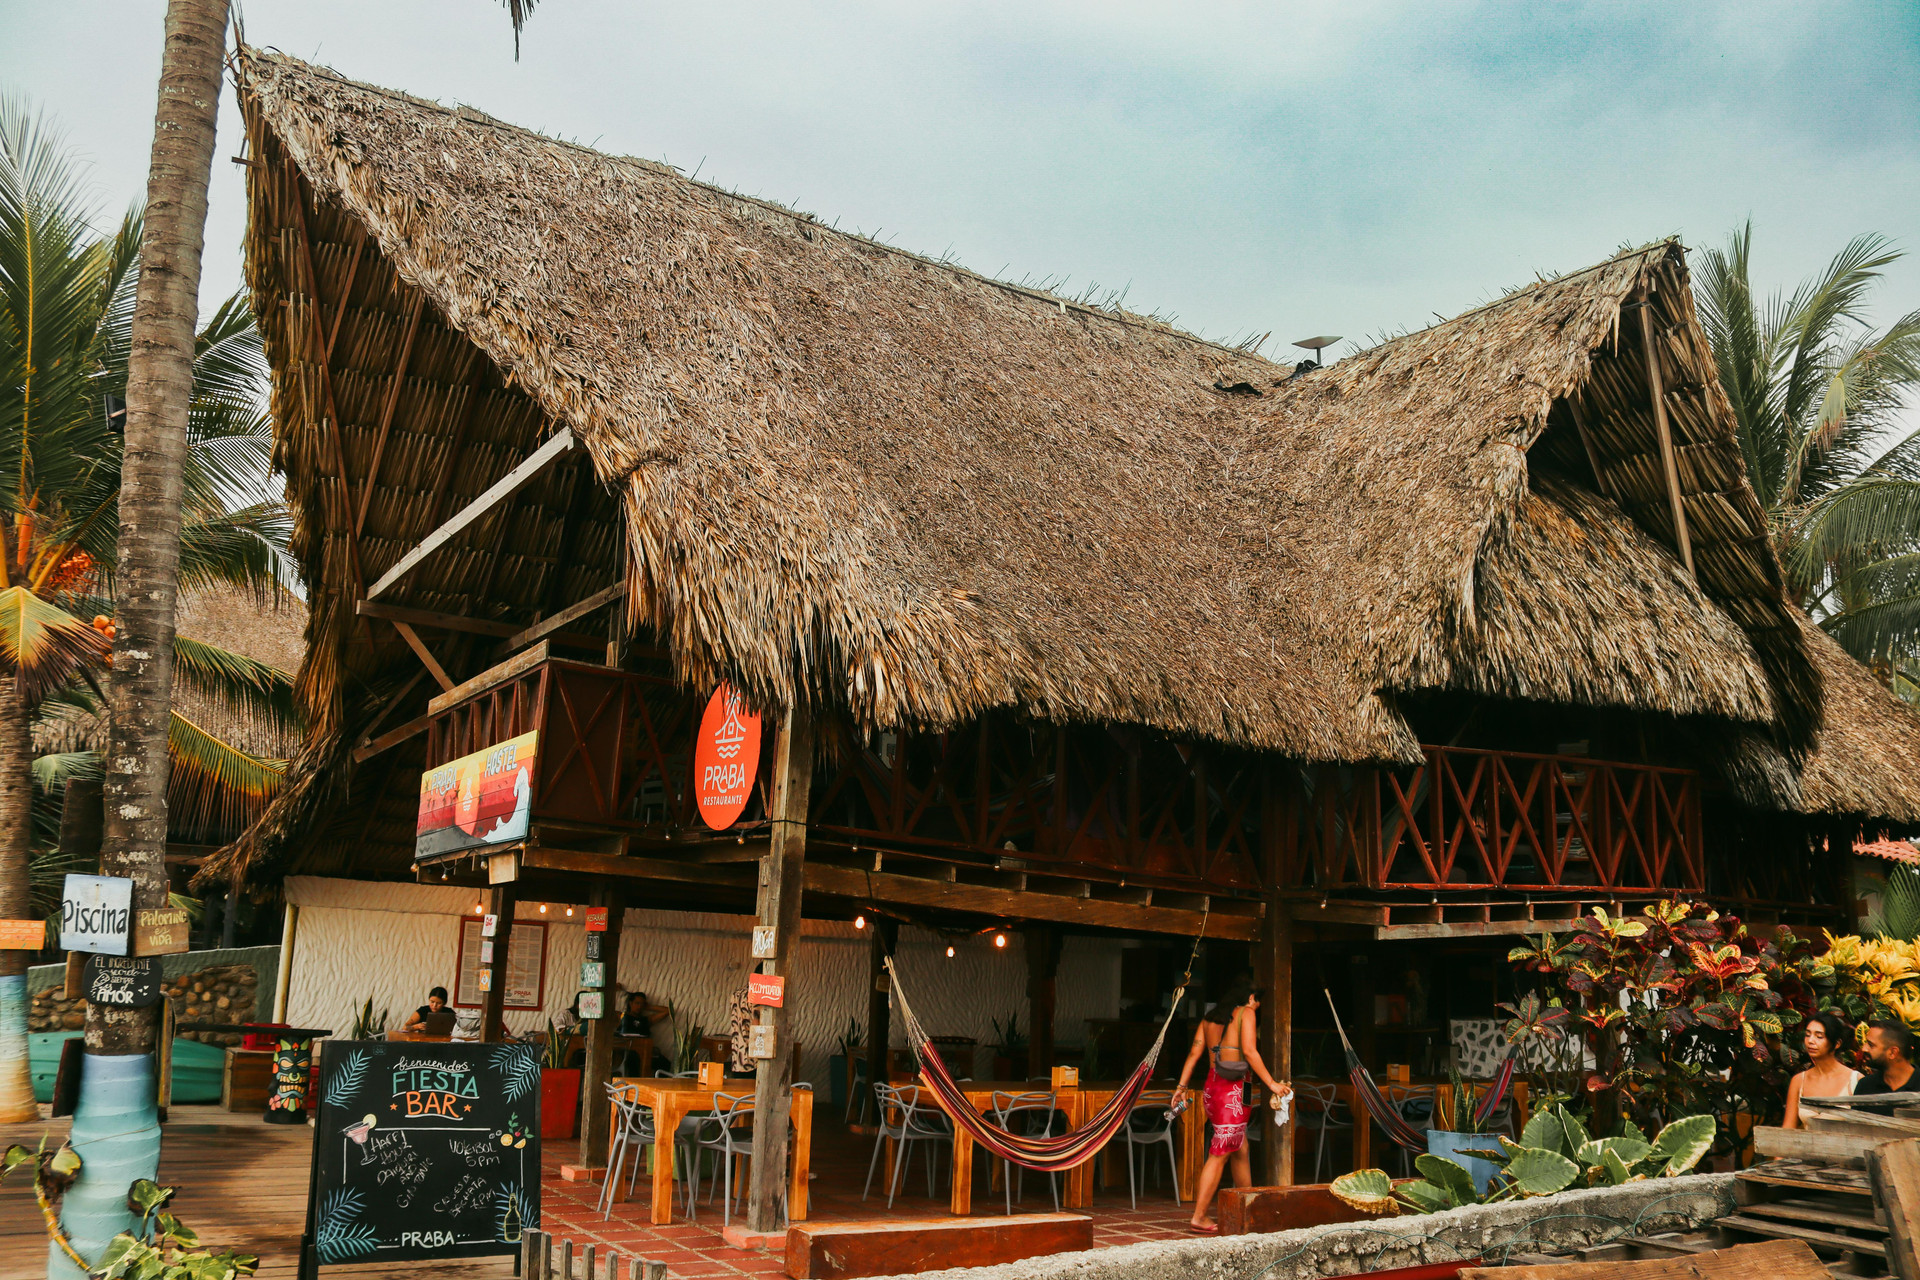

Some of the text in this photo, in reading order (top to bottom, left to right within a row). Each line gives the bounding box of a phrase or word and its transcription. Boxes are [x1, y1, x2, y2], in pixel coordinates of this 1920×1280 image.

[431, 744, 518, 796] PRABA HOSTEL
[703, 763, 746, 793] PRABA
[703, 795, 742, 806] RESTAURANTE
[62, 899, 128, 934] Piscina
[149, 935, 173, 946] VIDA
[753, 930, 775, 955] YOGA
[95, 956, 151, 971] EL INGREDIENTE
[111, 976, 135, 985] SIEMPRE
[96, 988, 134, 1004] AMOR
[393, 1056, 470, 1071] bienvenidos
[393, 1070, 478, 1097] FIESTA
[406, 1091, 459, 1118] BAR
[402, 1231, 454, 1248] PRABA
